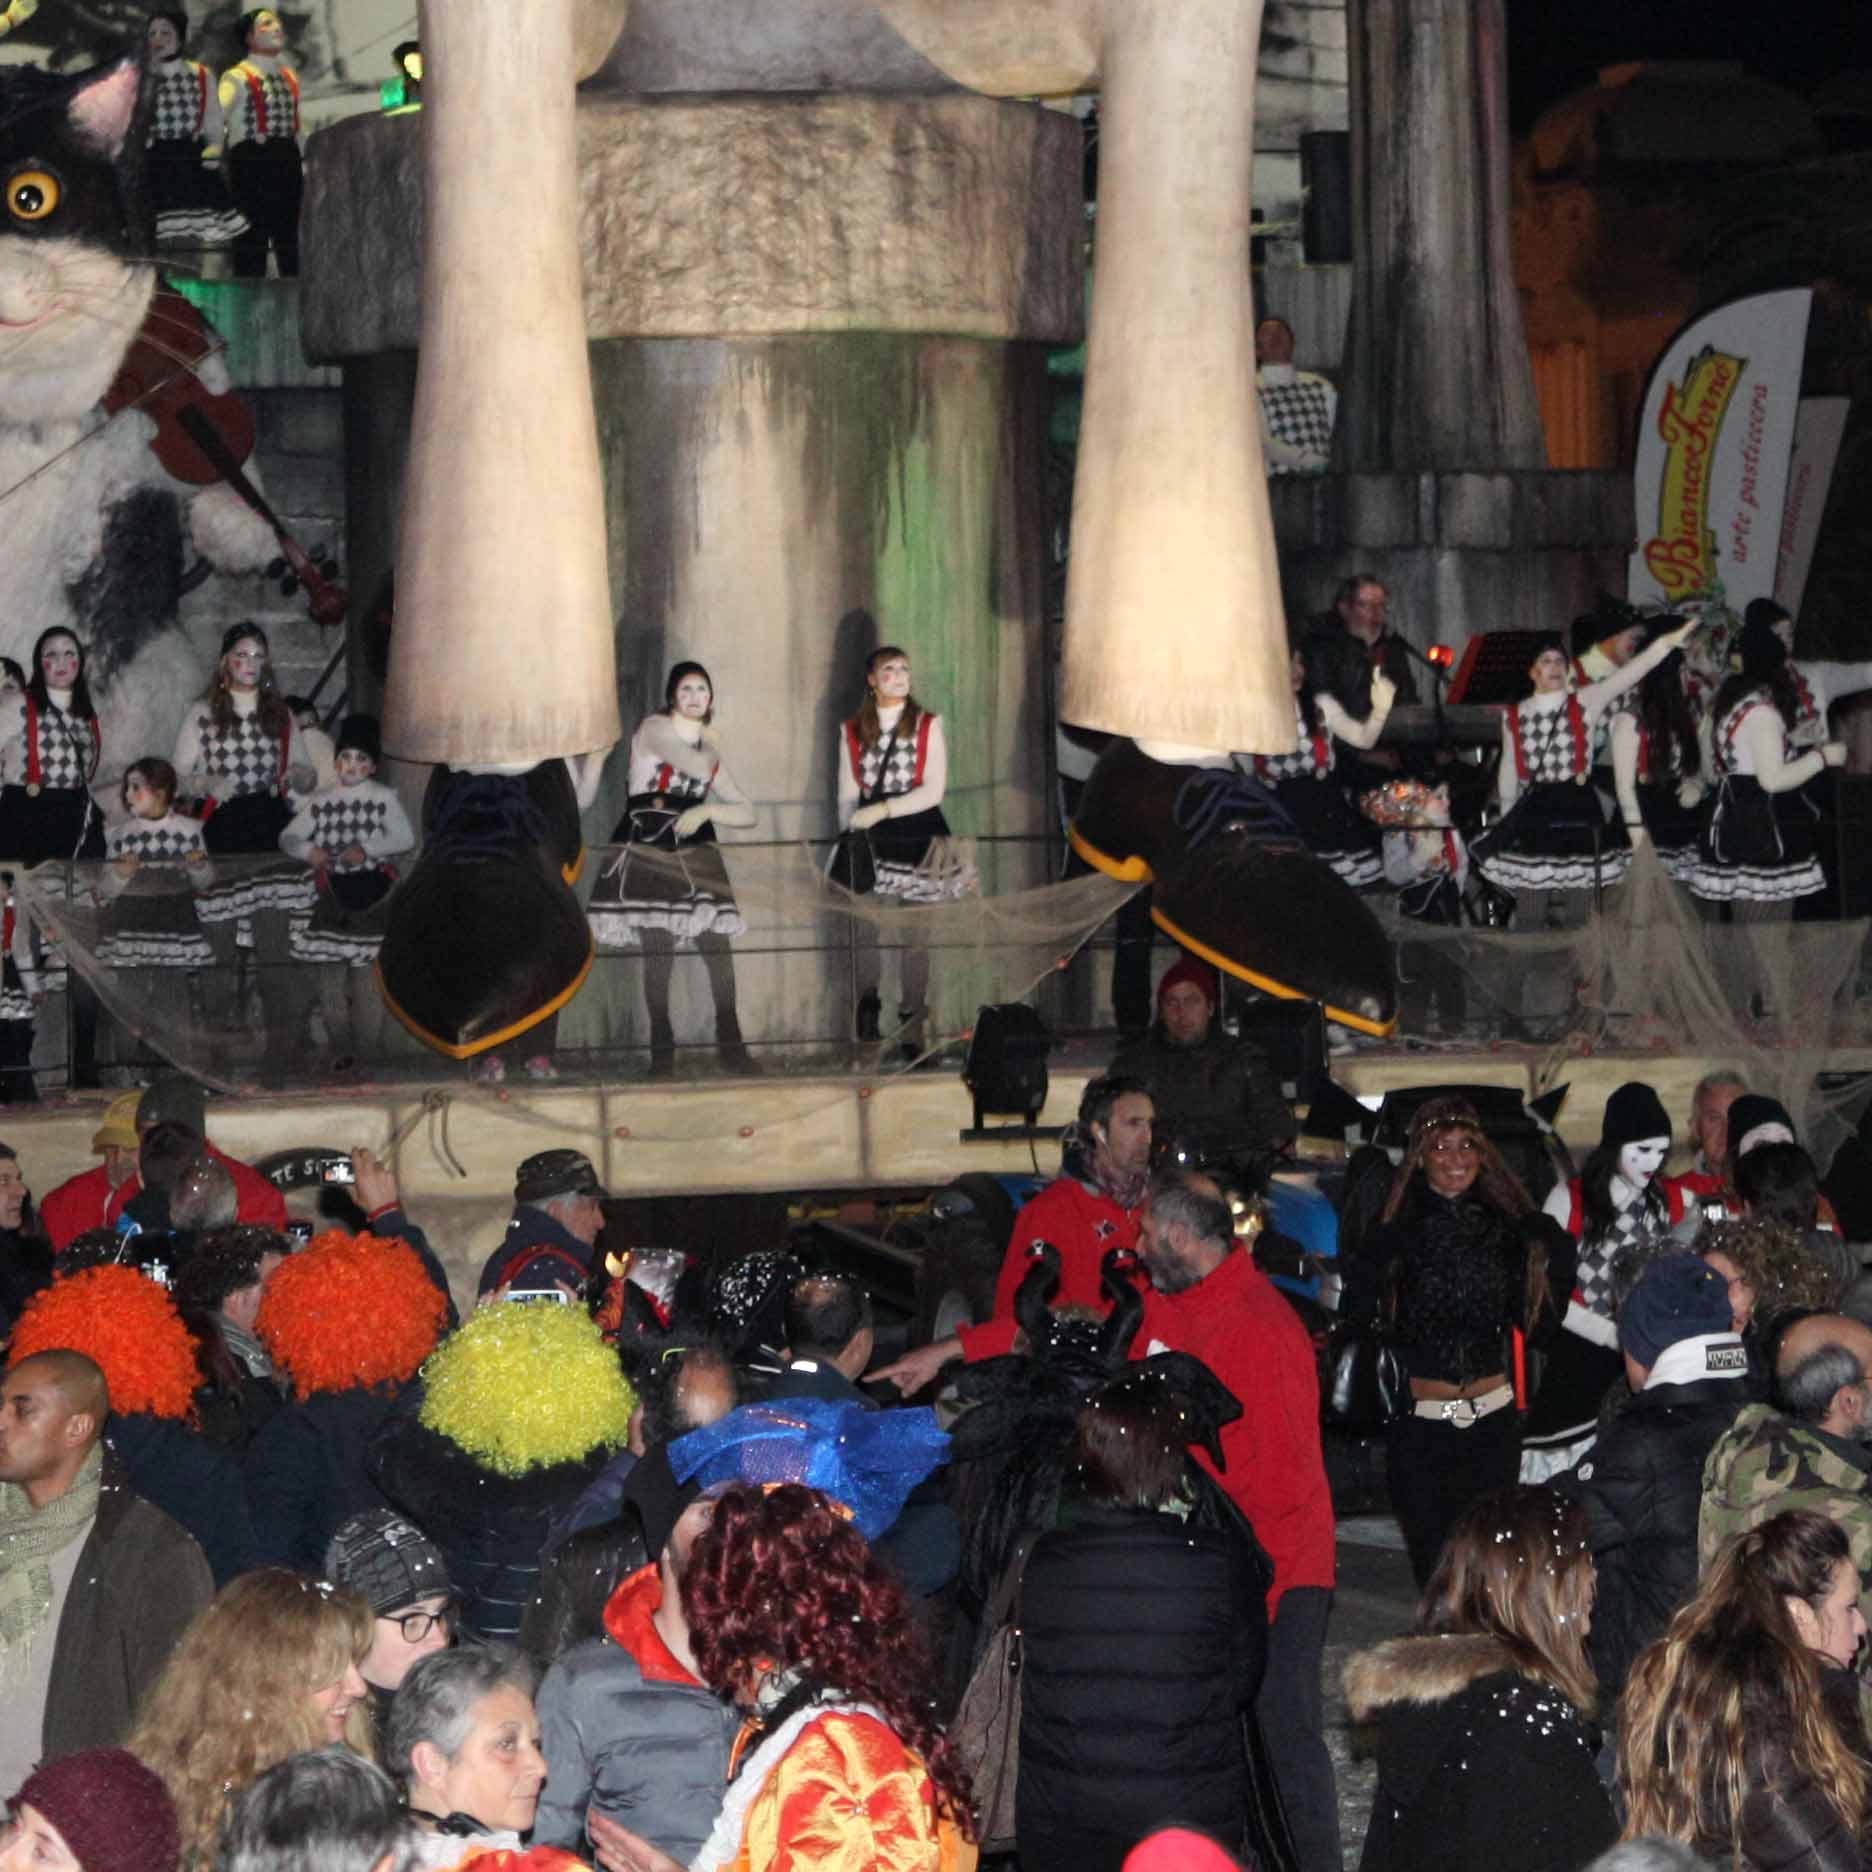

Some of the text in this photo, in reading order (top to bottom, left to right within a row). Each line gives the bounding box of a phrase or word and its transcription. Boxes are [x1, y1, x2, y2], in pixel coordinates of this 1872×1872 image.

[1644, 360, 1732, 590] BiancoForno
[1732, 383, 1769, 564] arte pasticcera
